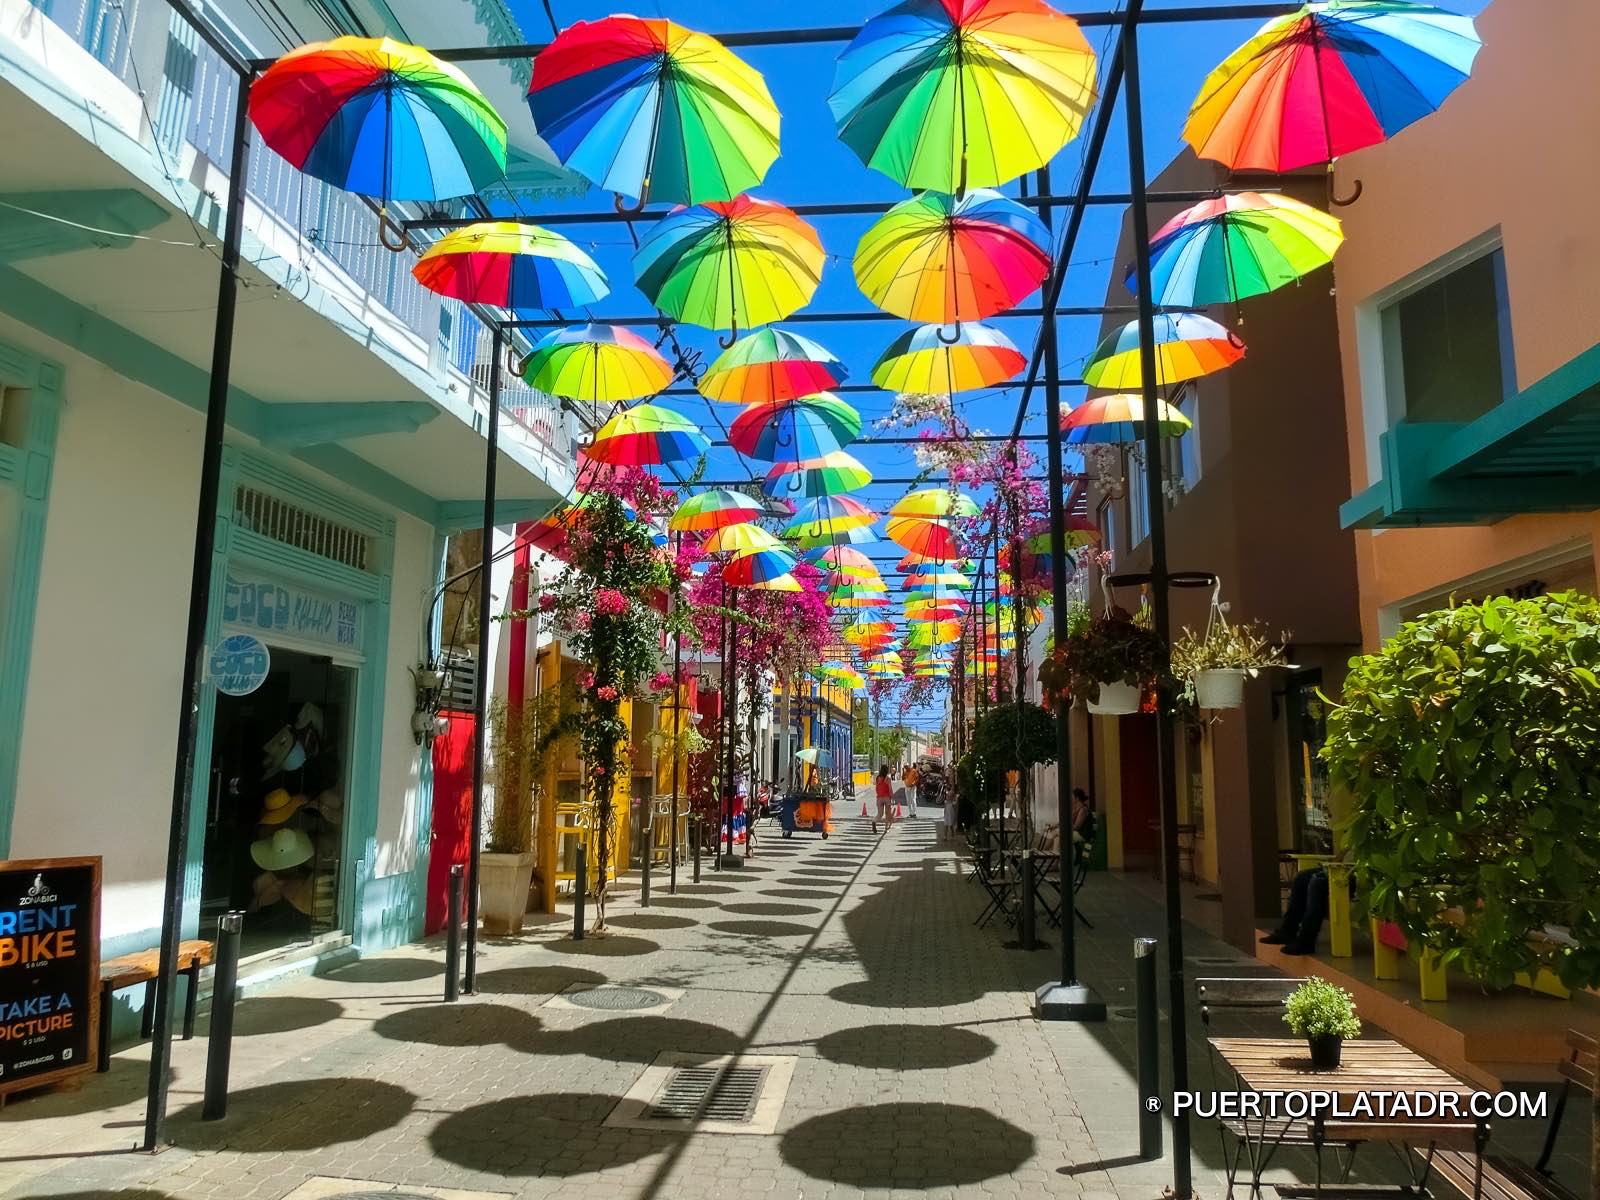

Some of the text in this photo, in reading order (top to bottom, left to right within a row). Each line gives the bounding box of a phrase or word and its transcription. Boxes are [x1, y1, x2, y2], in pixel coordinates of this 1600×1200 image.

[223, 579, 289, 630] COCO
[337, 623, 355, 645] WEAR
[210, 649, 266, 675] COCO
[19, 894, 57, 905] ZONABICI
[0, 904, 77, 936] RENT
[0, 929, 77, 967] BIKE
[0, 992, 72, 1022] TAKE A
